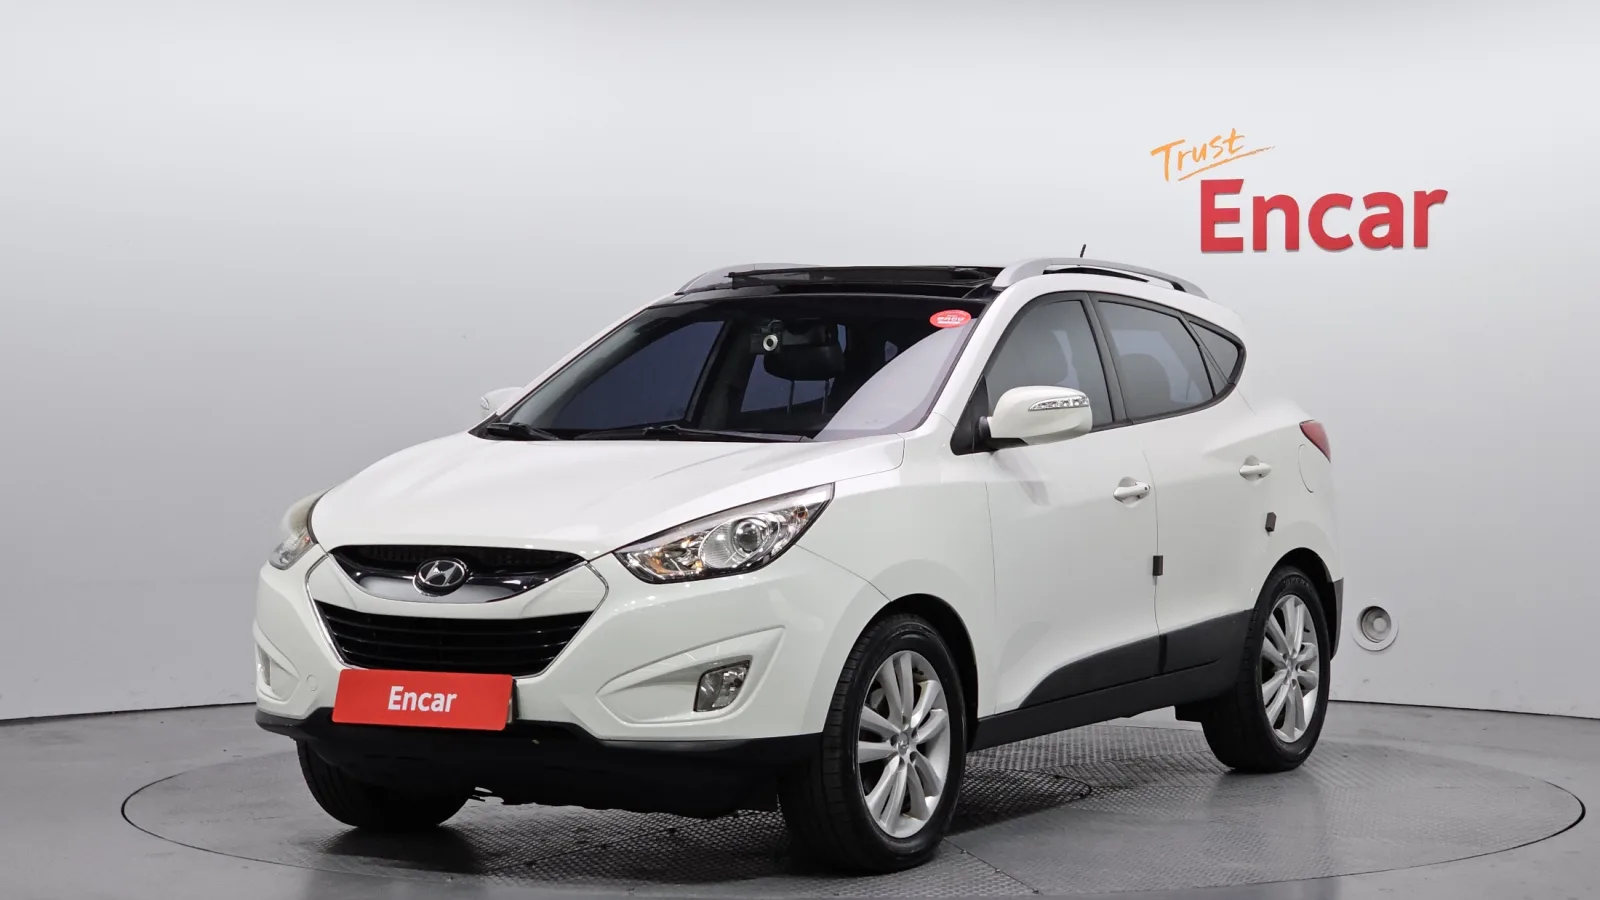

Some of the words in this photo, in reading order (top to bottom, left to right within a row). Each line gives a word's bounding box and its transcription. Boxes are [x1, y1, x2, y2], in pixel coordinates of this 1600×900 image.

[1150, 128, 1245, 181] Trust
[1200, 178, 1448, 252] Encar
[387, 685, 458, 712] Encar
